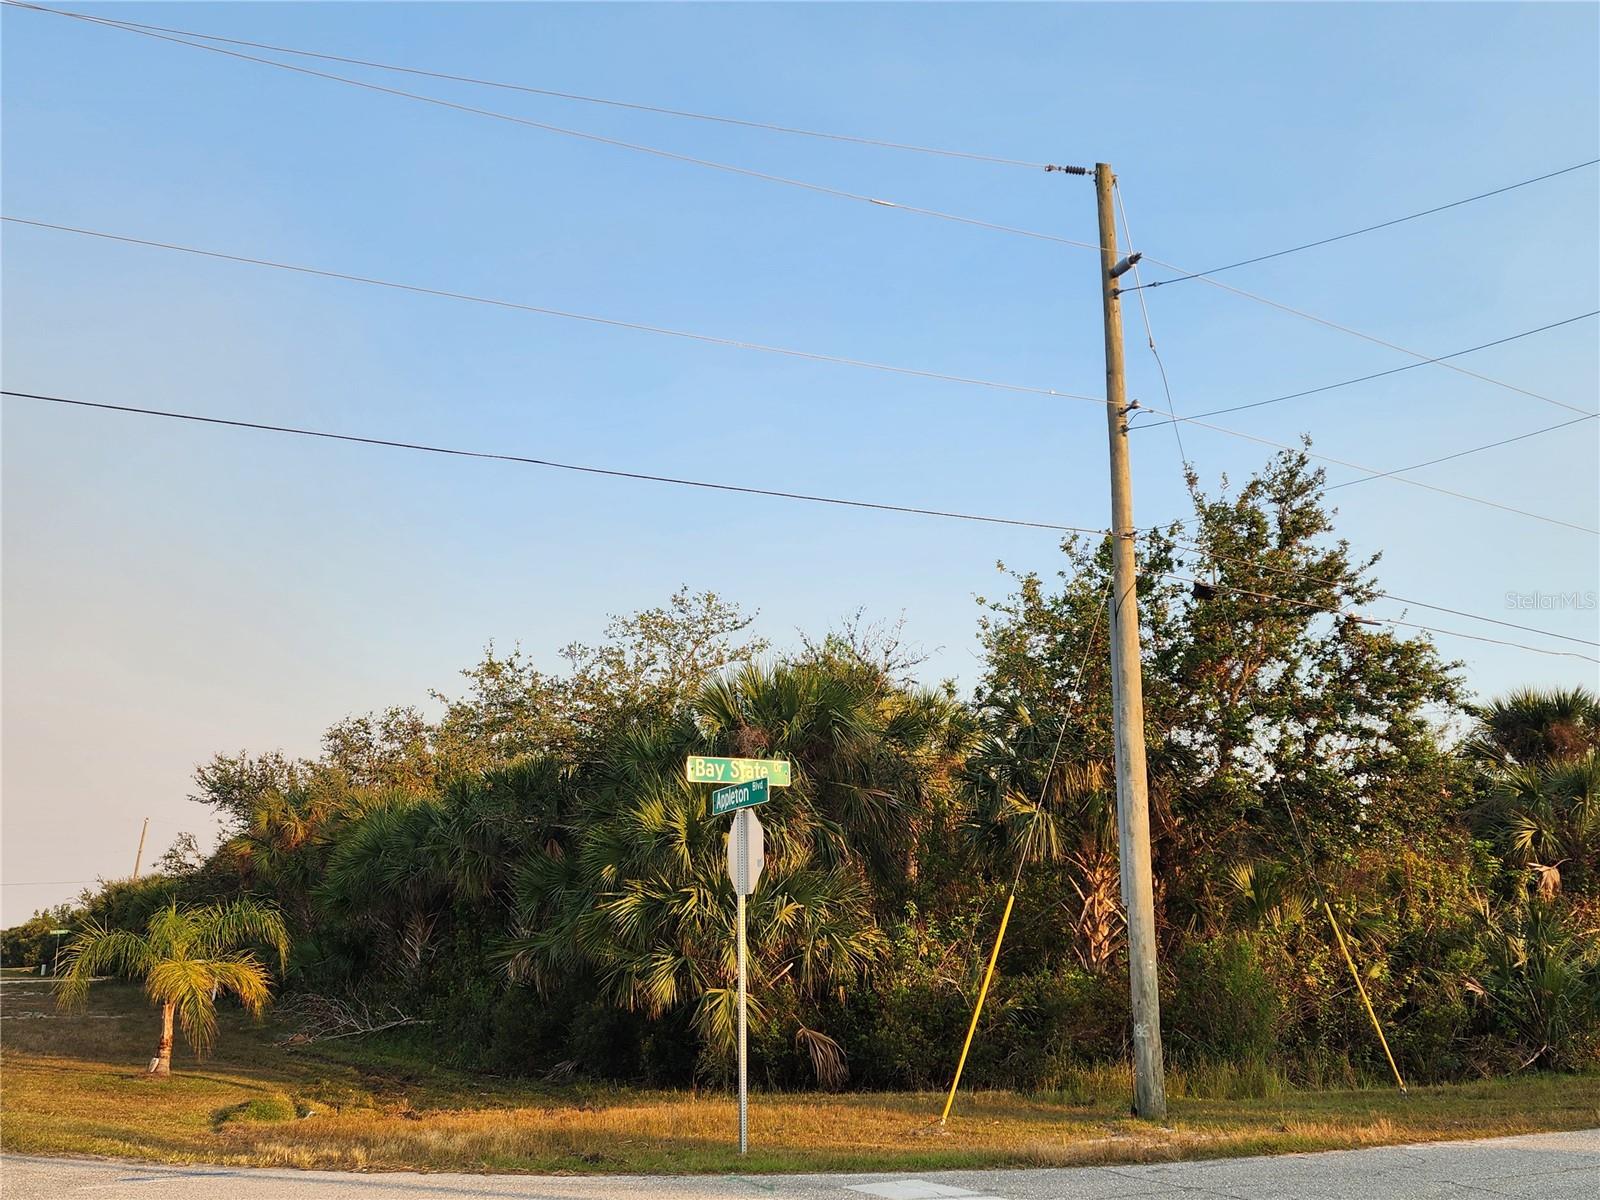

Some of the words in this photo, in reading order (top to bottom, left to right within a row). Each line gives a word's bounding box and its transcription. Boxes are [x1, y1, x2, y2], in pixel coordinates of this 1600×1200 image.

[695, 759, 724, 780] Bay
[730, 761, 768, 778] State
[773, 763, 782, 773] Dr
[716, 788, 749, 810] Appleton
[752, 782, 763, 791] Blvd
